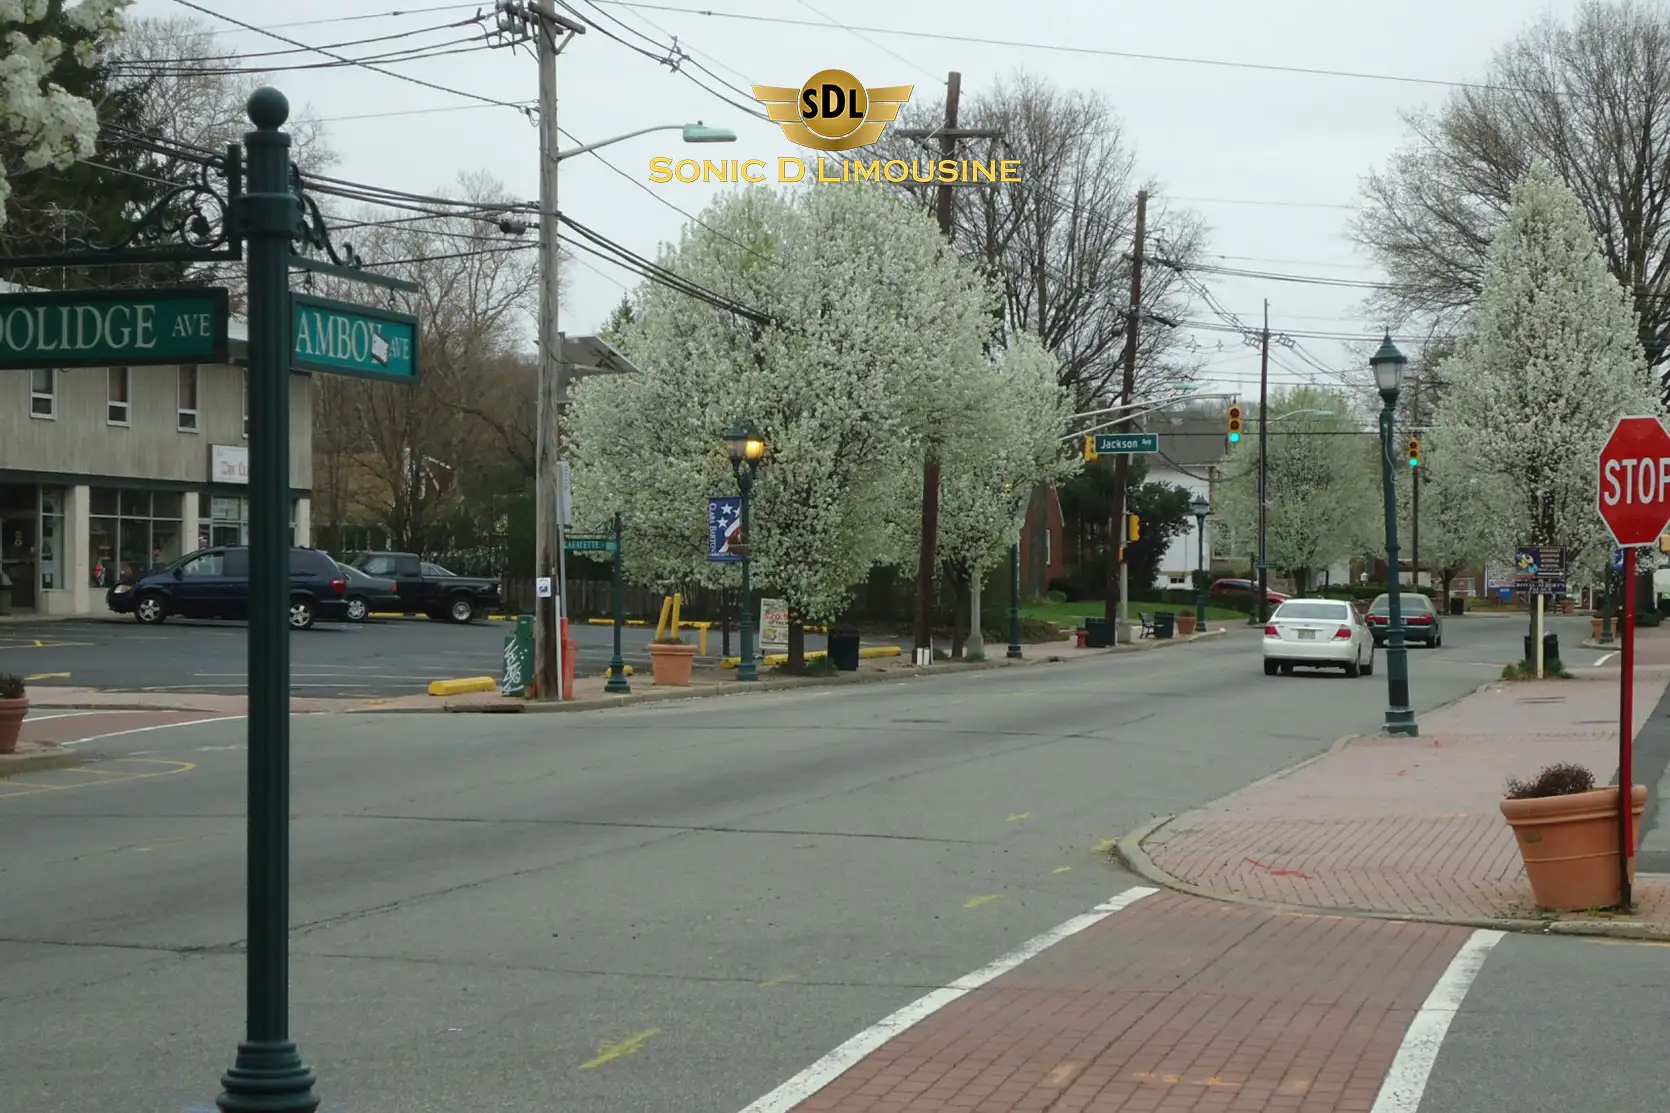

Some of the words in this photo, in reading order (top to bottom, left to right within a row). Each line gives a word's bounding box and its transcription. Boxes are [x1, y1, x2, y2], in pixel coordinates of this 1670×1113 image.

[0, 304, 157, 351] OLIDGE
[171, 313, 211, 337] AVE
[389, 336, 410, 360] AVE
[1101, 439, 1138, 449] Jackson
[1604, 457, 1670, 506] STOP
[564, 540, 601, 550] LAFAYETTE
[709, 526, 717, 552] BARTON
